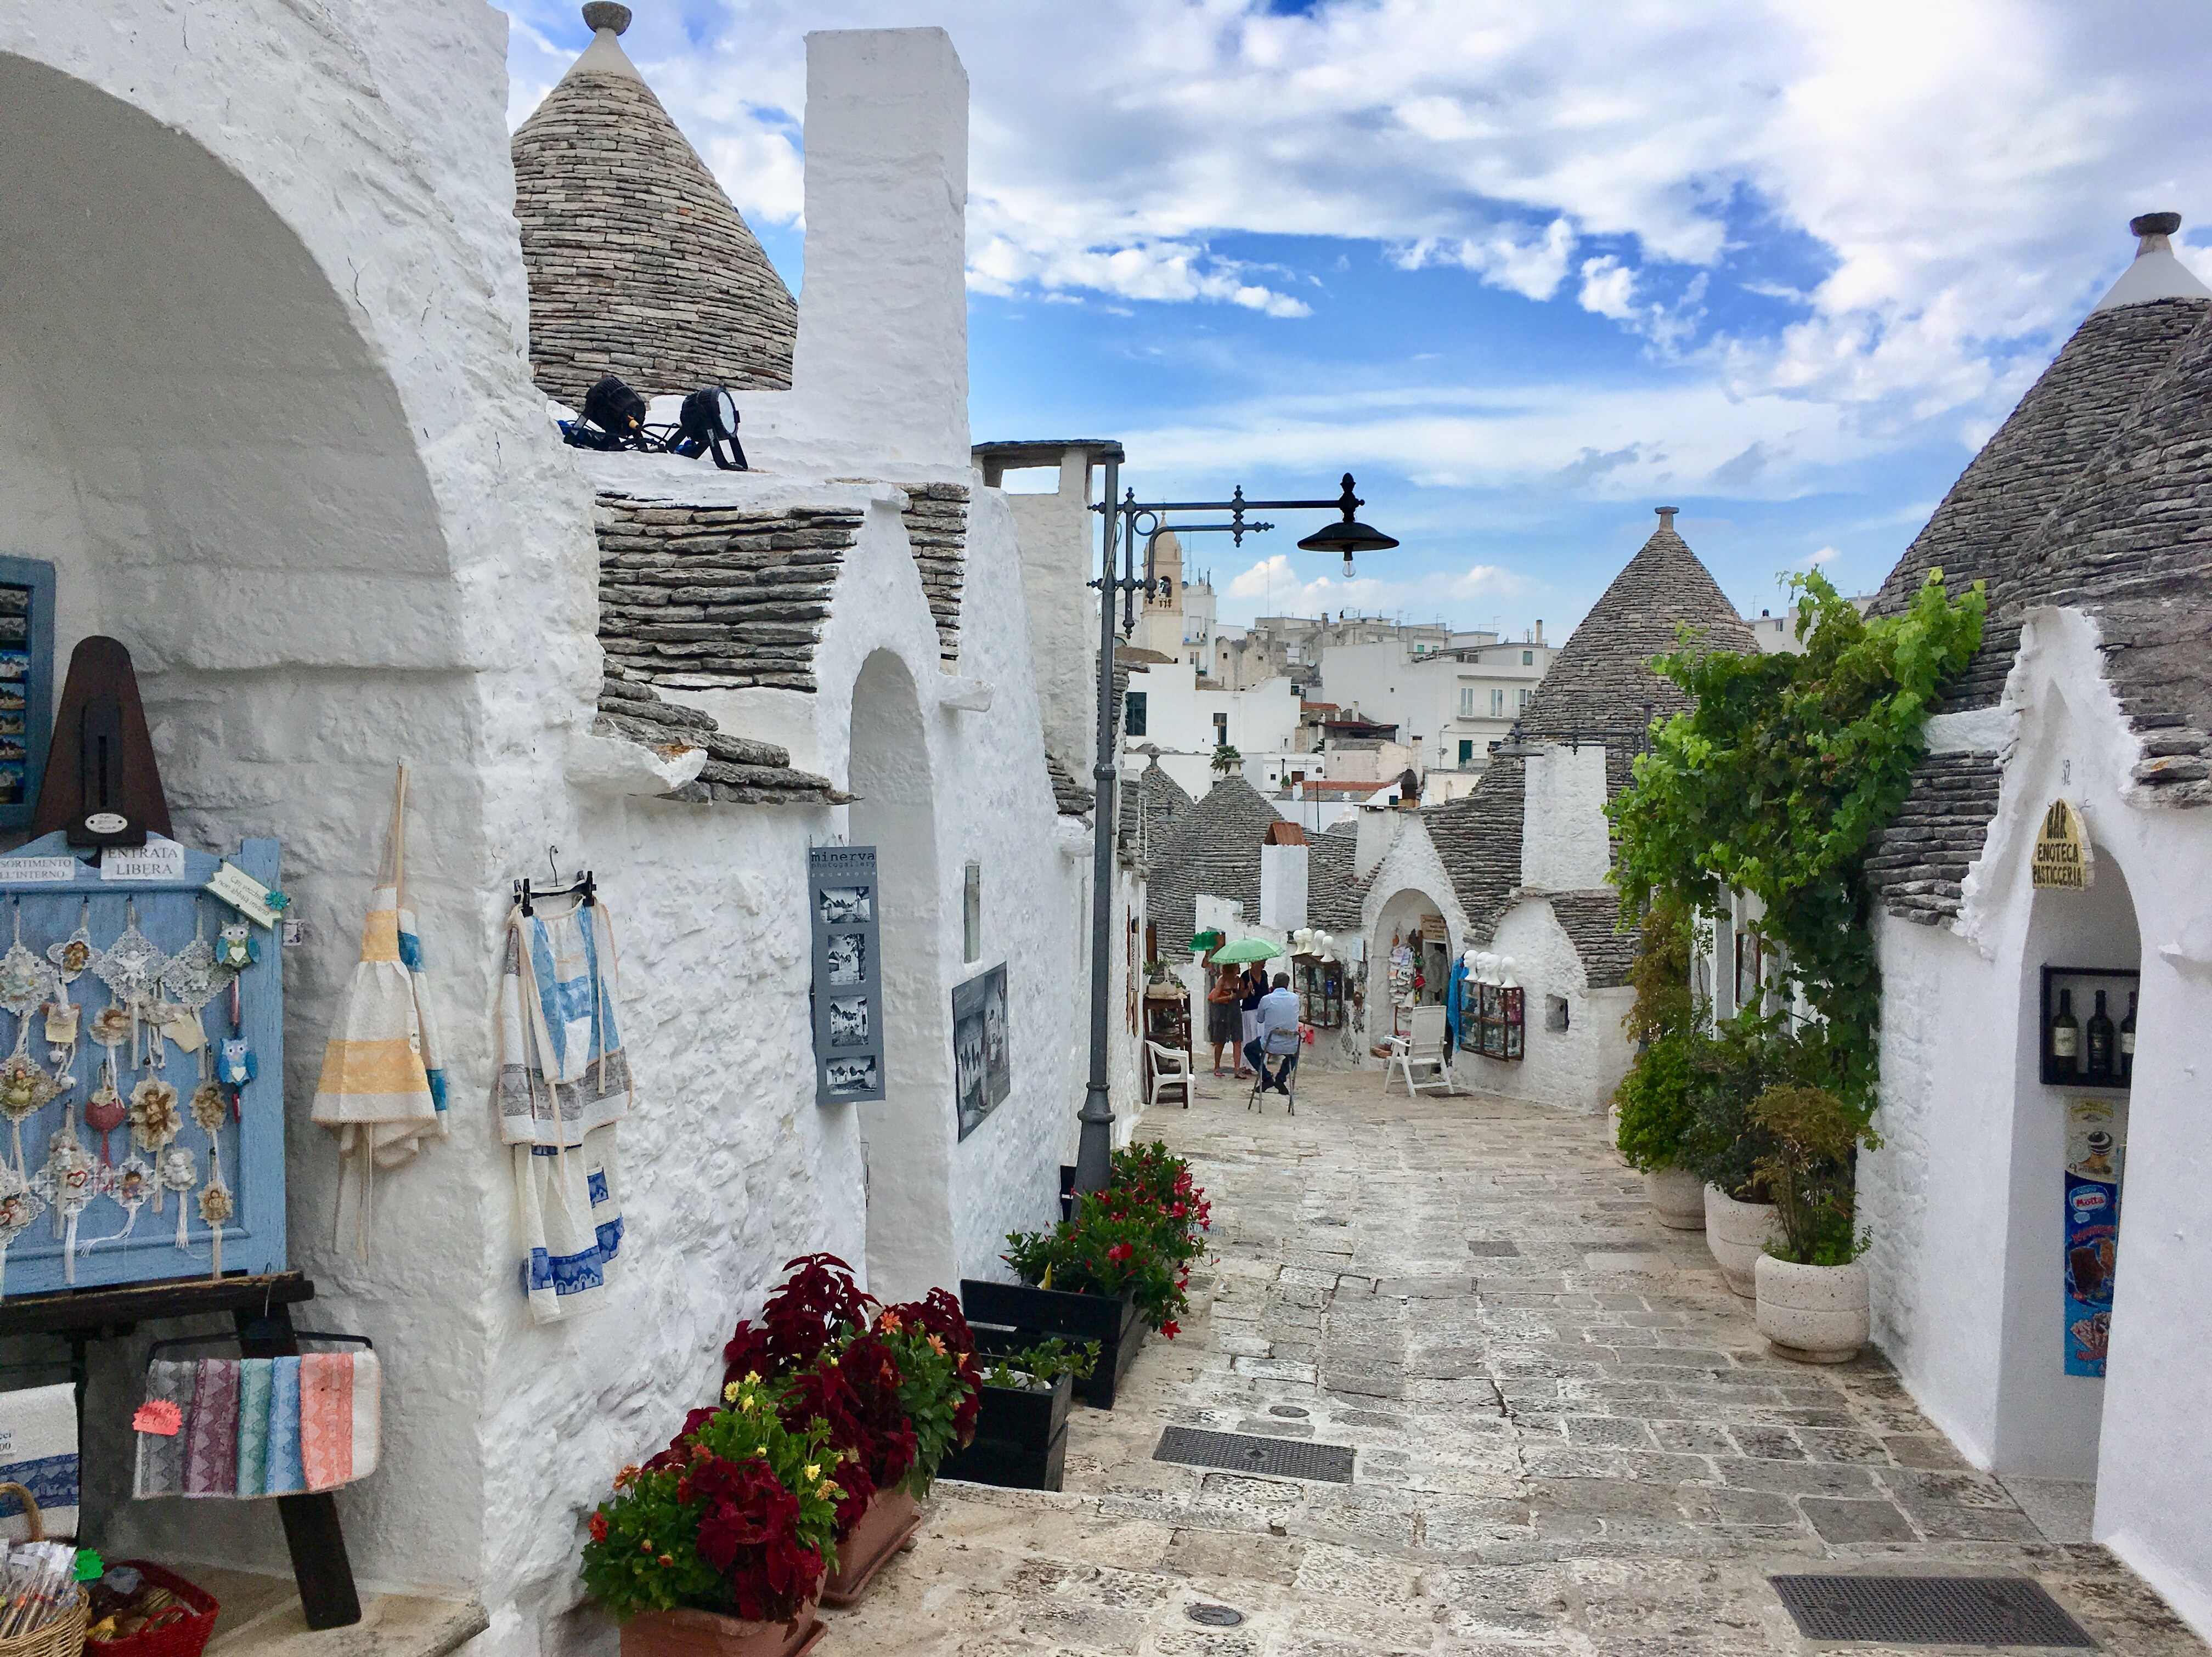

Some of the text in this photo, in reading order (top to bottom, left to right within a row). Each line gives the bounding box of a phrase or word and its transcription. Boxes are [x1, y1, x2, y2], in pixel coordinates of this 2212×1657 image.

[2046, 801, 2067, 839] BAR
[108, 846, 178, 858] ENTRATA
[811, 852, 875, 862] minerva
[2037, 842, 2079, 863] ENOTECA
[116, 863, 173, 875] LIBERA
[2033, 864, 2083, 887] PASTICCERIA
[2076, 1196, 2105, 1207] Motta
